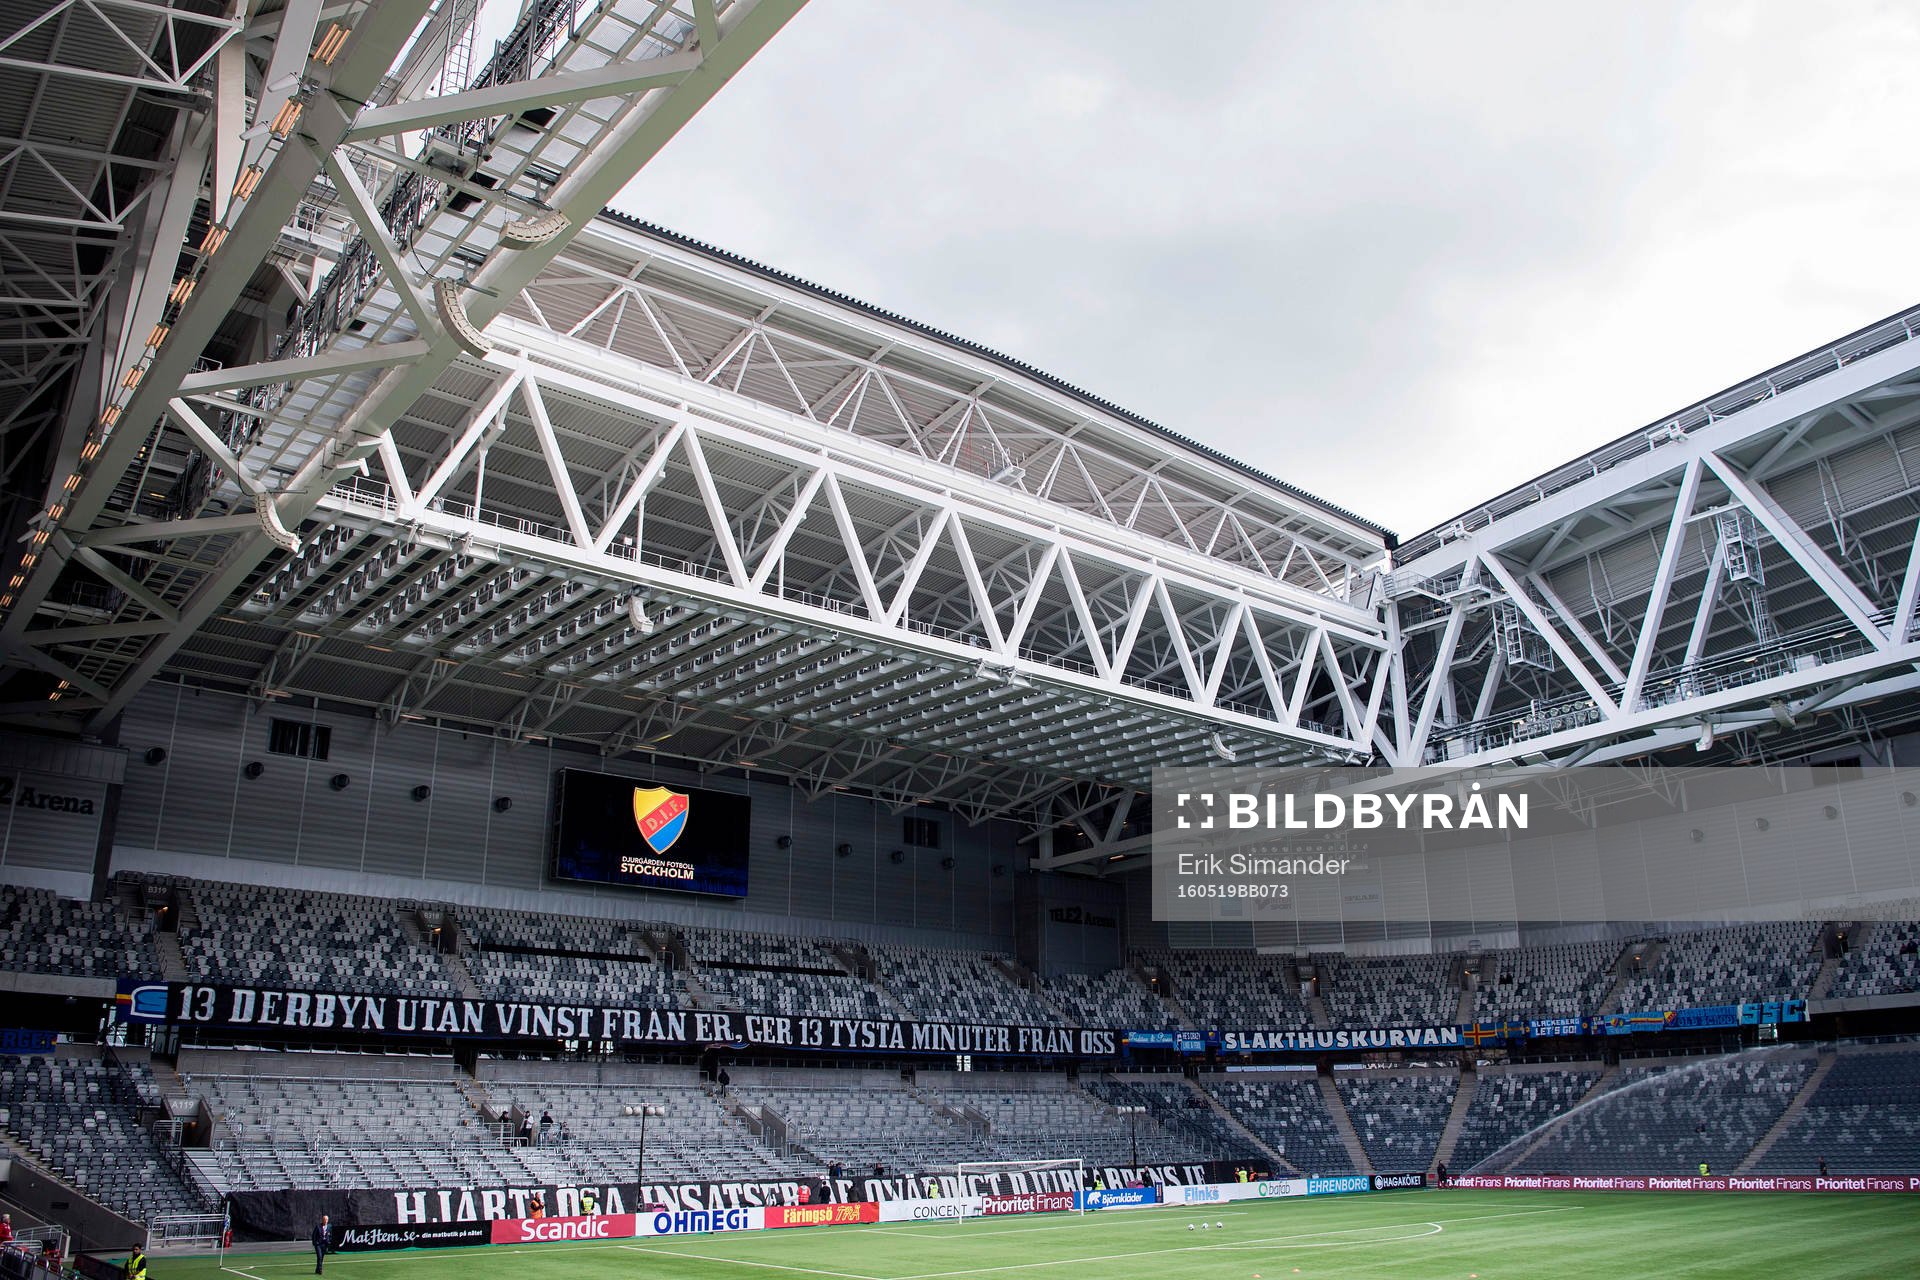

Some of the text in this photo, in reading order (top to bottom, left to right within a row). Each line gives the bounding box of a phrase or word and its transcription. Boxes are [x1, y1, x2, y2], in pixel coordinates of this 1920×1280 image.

[16, 786, 94, 815] Arena
[622, 855, 695, 871] DJURGÅRDEN FOTBOLL
[620, 863, 694, 880] STOCKHOLM
[177, 985, 217, 1022] 13
[228, 988, 387, 1031] DERBYN
[397, 998, 486, 1033] UTAN
[495, 1003, 594, 1038] VINST
[798, 1018, 824, 1047] 13
[830, 1019, 905, 1050] TYSTA
[911, 1022, 1011, 1052] MINUTER
[1081, 1030, 1116, 1054] OSS
[1225, 1026, 1458, 1050] SLAKTHUSKURVAN
[1183, 1164, 1206, 1187] IF
[1383, 1174, 1421, 1187] HAGAKÖKET
[1475, 1176, 1502, 1188] Finans
[1504, 1176, 1570, 1189] Prioritet Finans
[1573, 1177, 1645, 1189] Prioritet Finans
[1648, 1177, 1725, 1189] Prioritet Finans
[1309, 1177, 1369, 1194] EHRENBORG
[1729, 1178, 1811, 1190] Prioritet Finans
[1815, 1178, 1865, 1190] Prioritet
[1866, 1178, 1904, 1190] Finans
[1102, 1191, 1143, 1205] Björnkläder
[1184, 1187, 1219, 1202] Flinks
[914, 1204, 967, 1218] CONCENT
[982, 1193, 1074, 1215] Prioritet Finans
[783, 1206, 833, 1224] Färingsö
[432, 1230, 458, 1238] matbutik
[520, 1214, 609, 1241] Scandic
